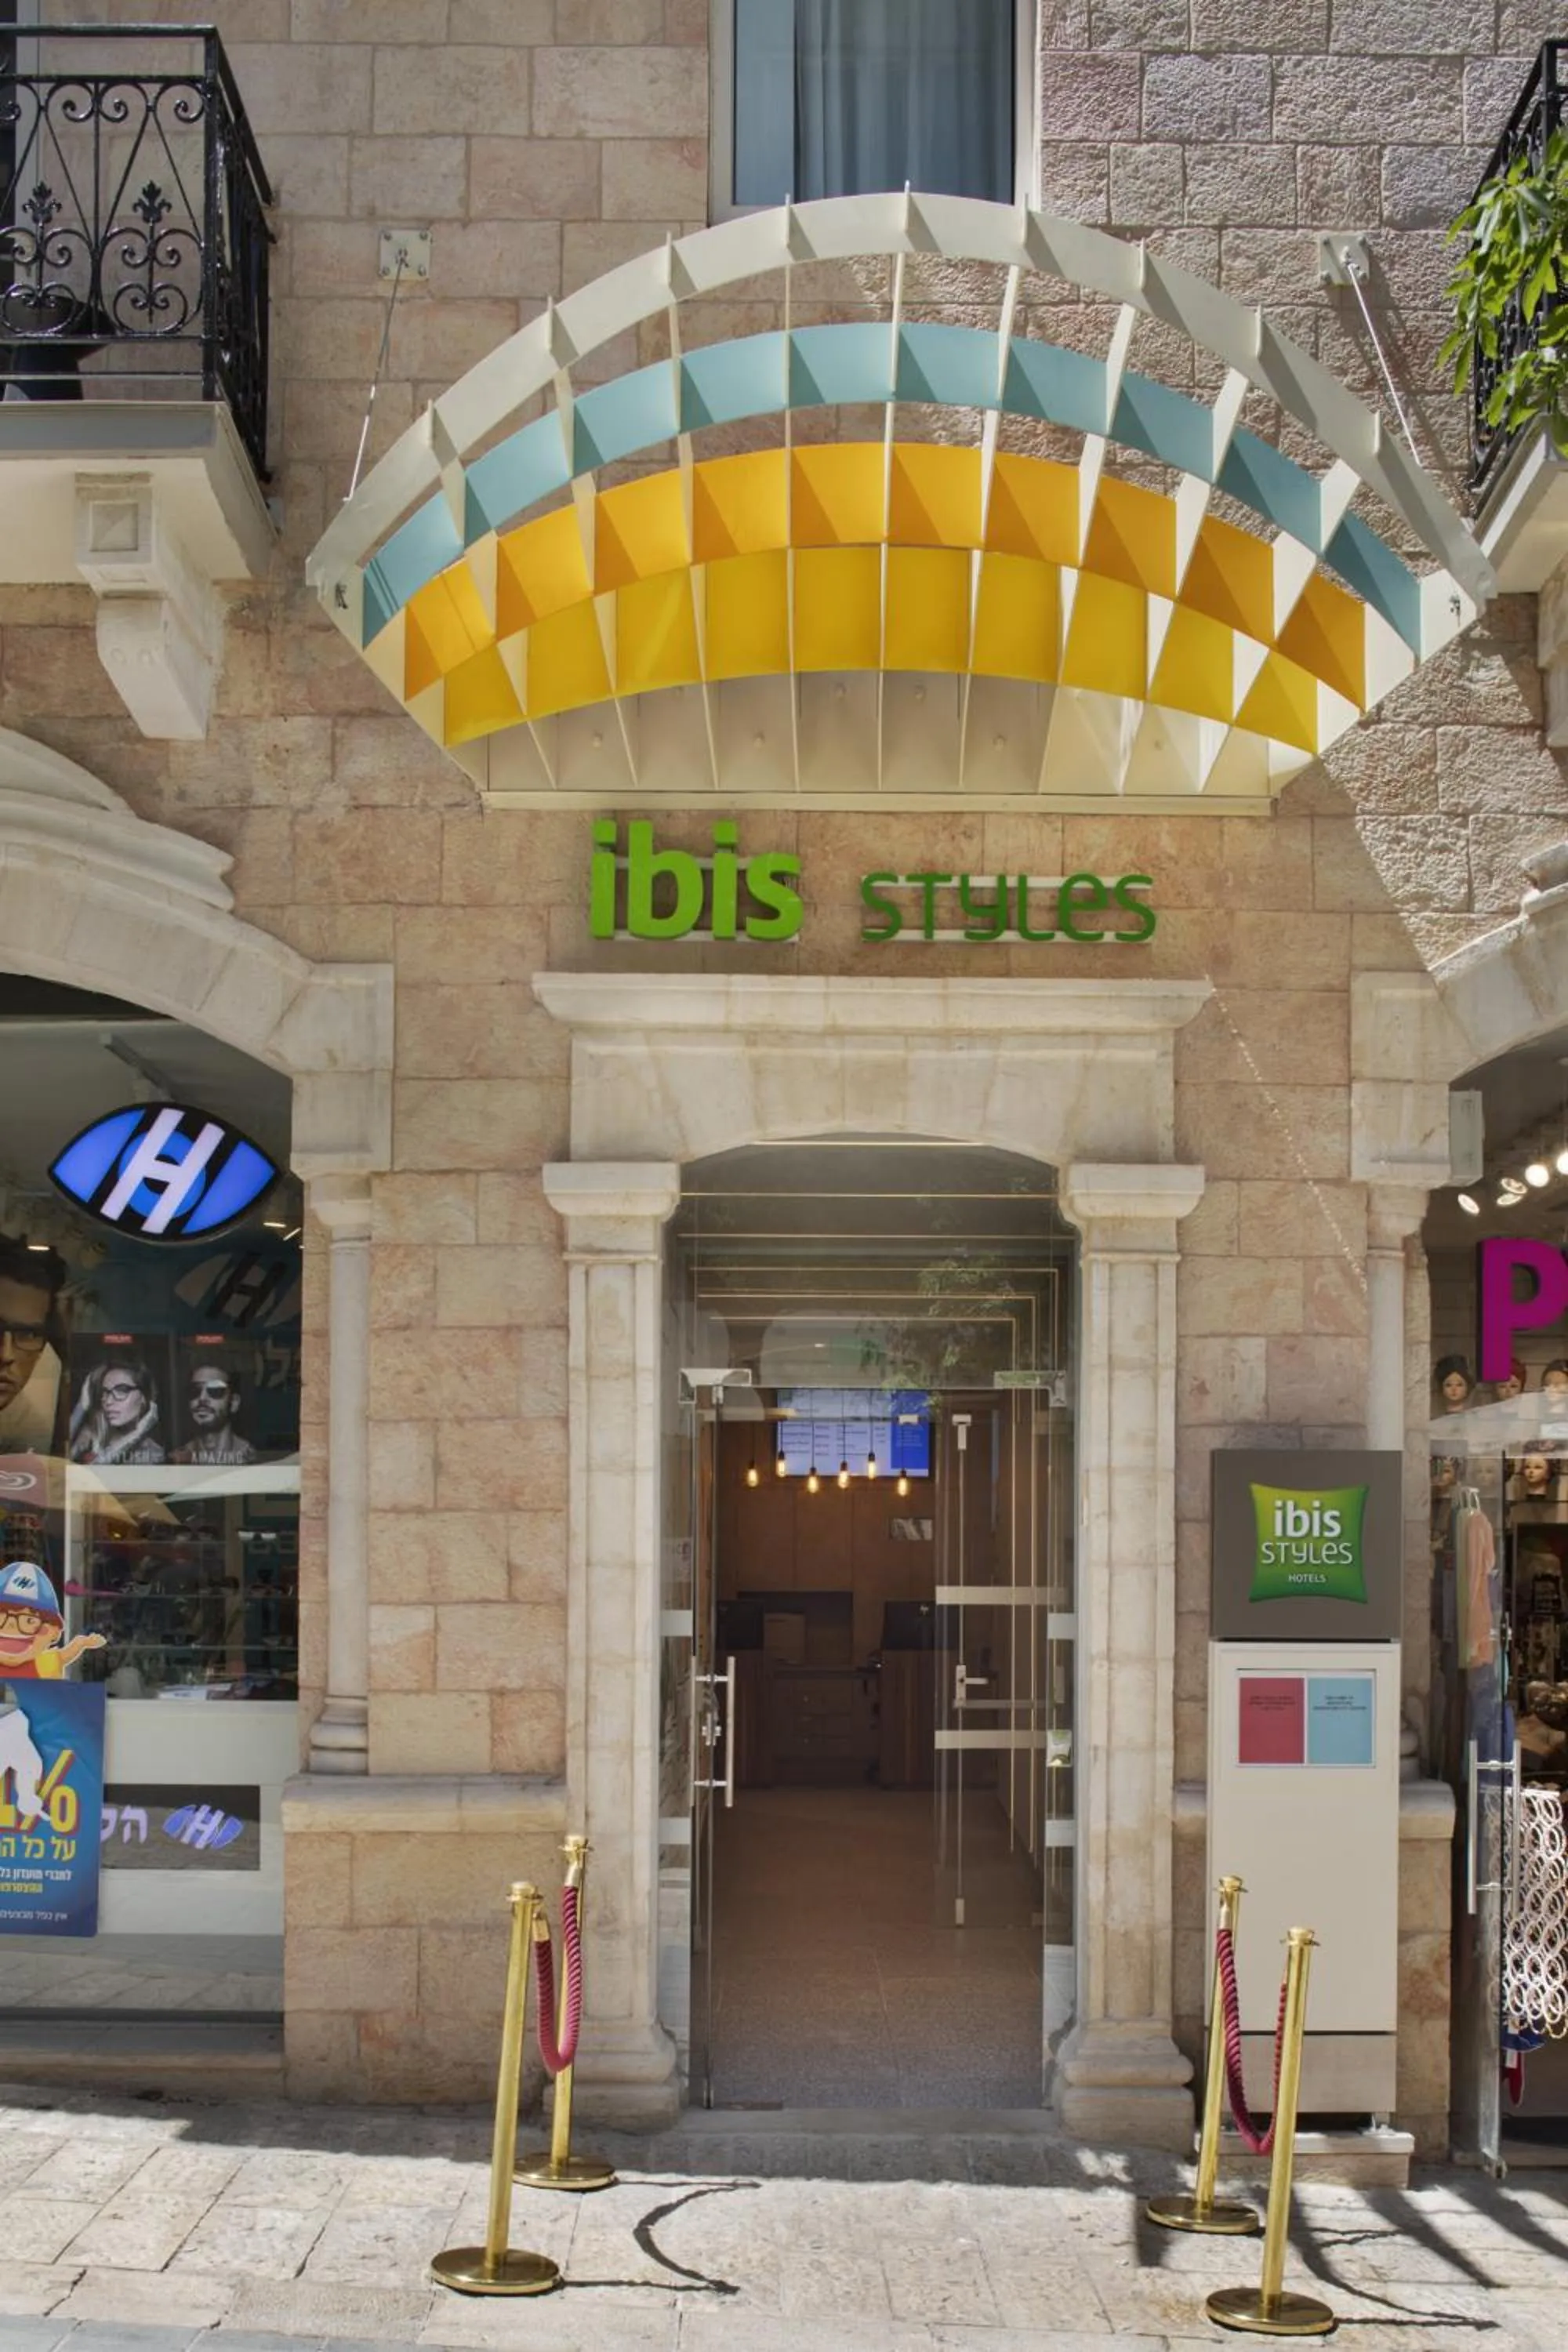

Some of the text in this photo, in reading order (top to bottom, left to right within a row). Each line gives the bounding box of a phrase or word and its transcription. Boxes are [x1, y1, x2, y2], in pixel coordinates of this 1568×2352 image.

[590, 818, 804, 941] ibis
[100, 1107, 225, 1234] H
[1274, 1500, 1342, 1538] ibis
[1288, 1573, 1327, 1584] HOTELS
[0, 1835, 76, 1861] על כל ה
